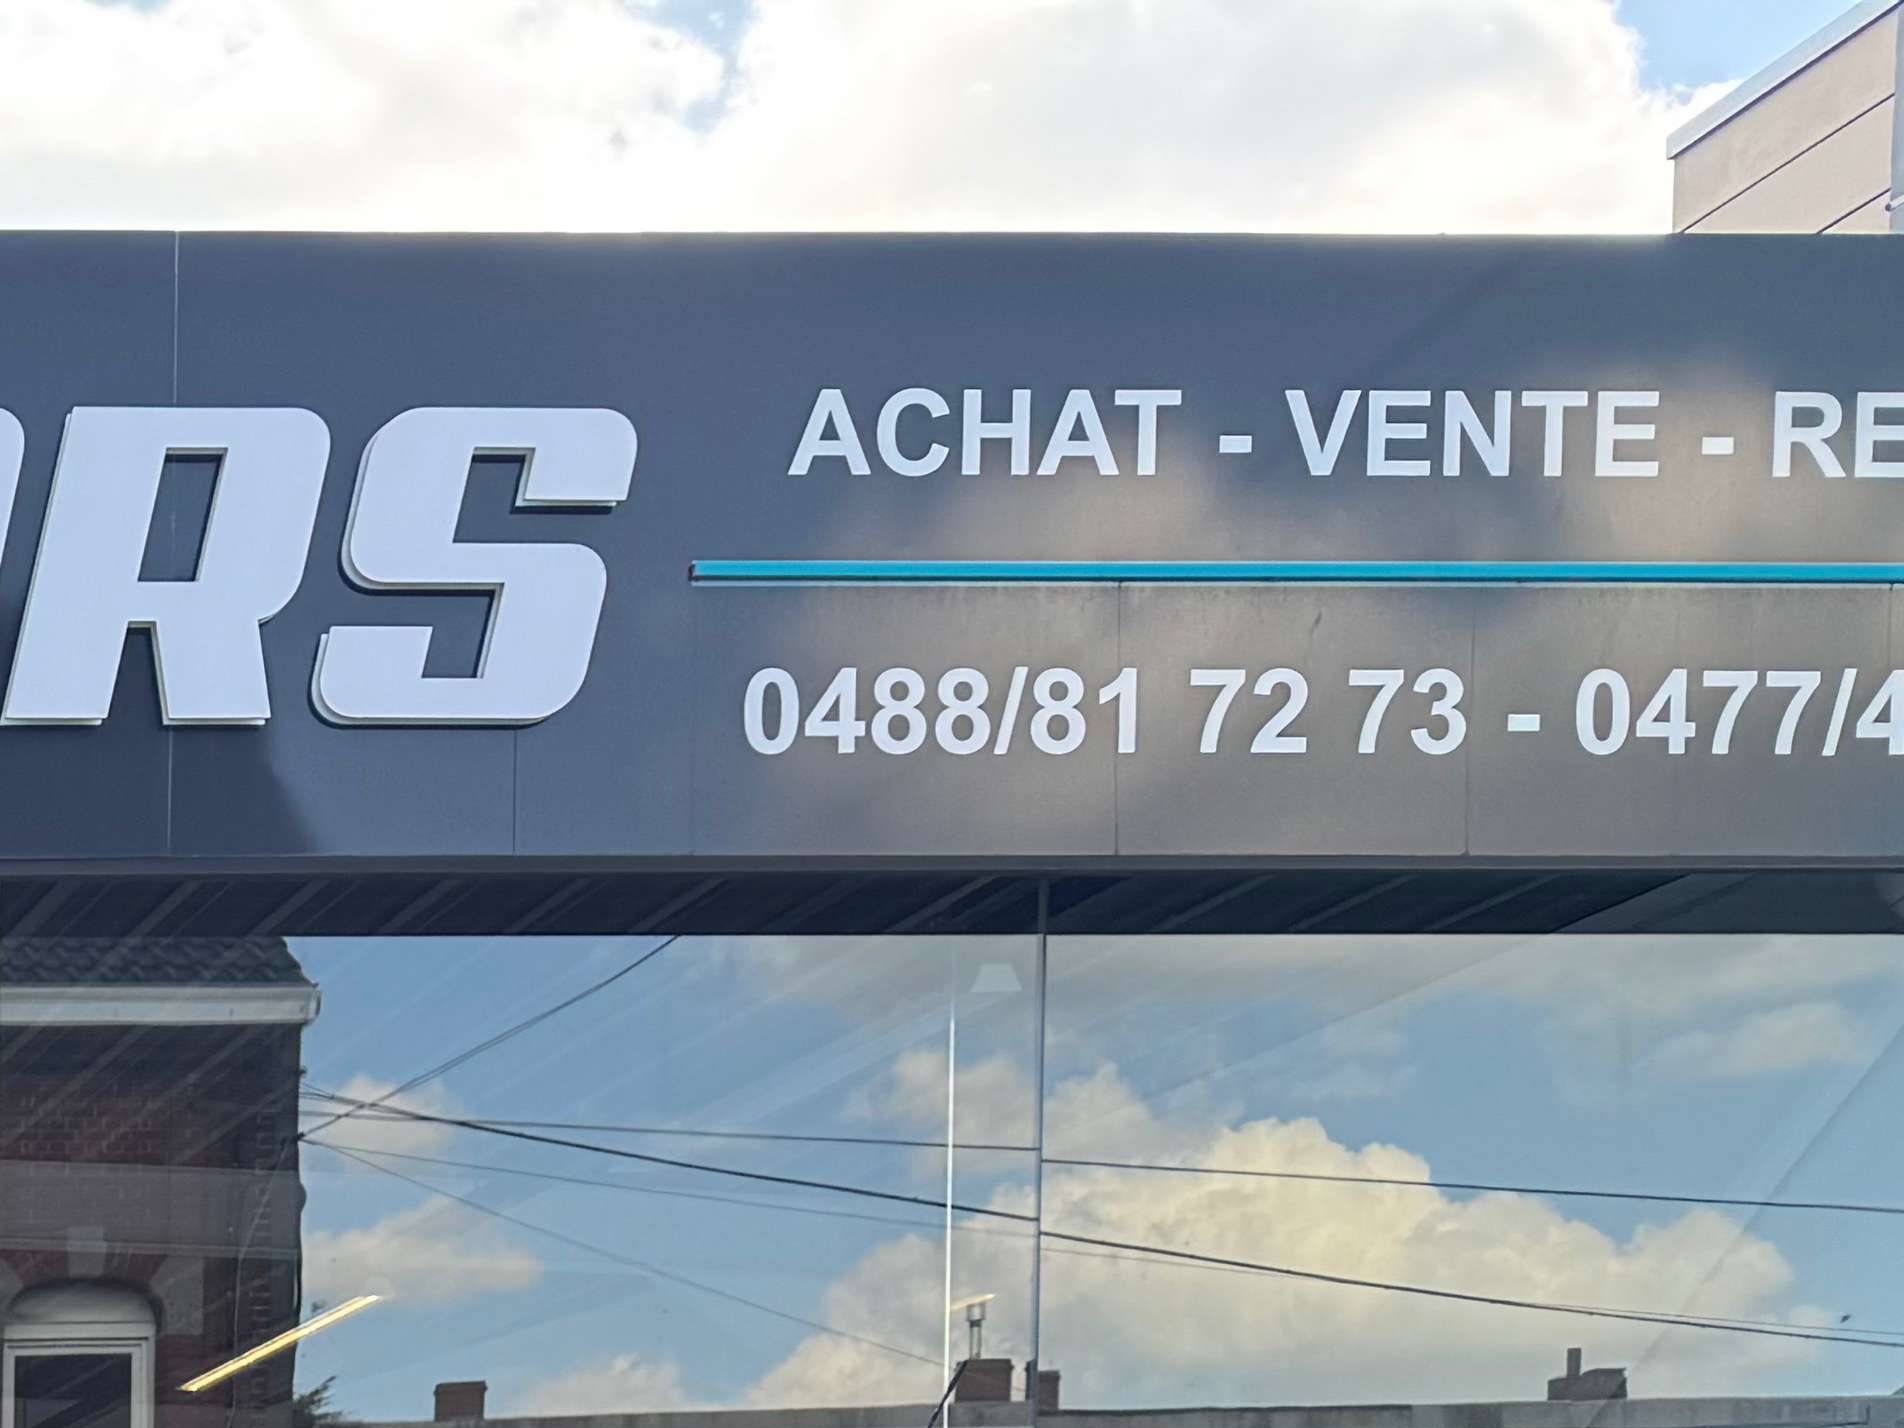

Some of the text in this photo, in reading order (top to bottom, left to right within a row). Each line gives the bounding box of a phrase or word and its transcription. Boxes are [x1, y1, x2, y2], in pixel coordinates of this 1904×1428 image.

[788, 387, 1904, 480] ACHAT - VENTE - RE
[743, 665, 1904, 757] 0488/81 72 73 - 0477/4
